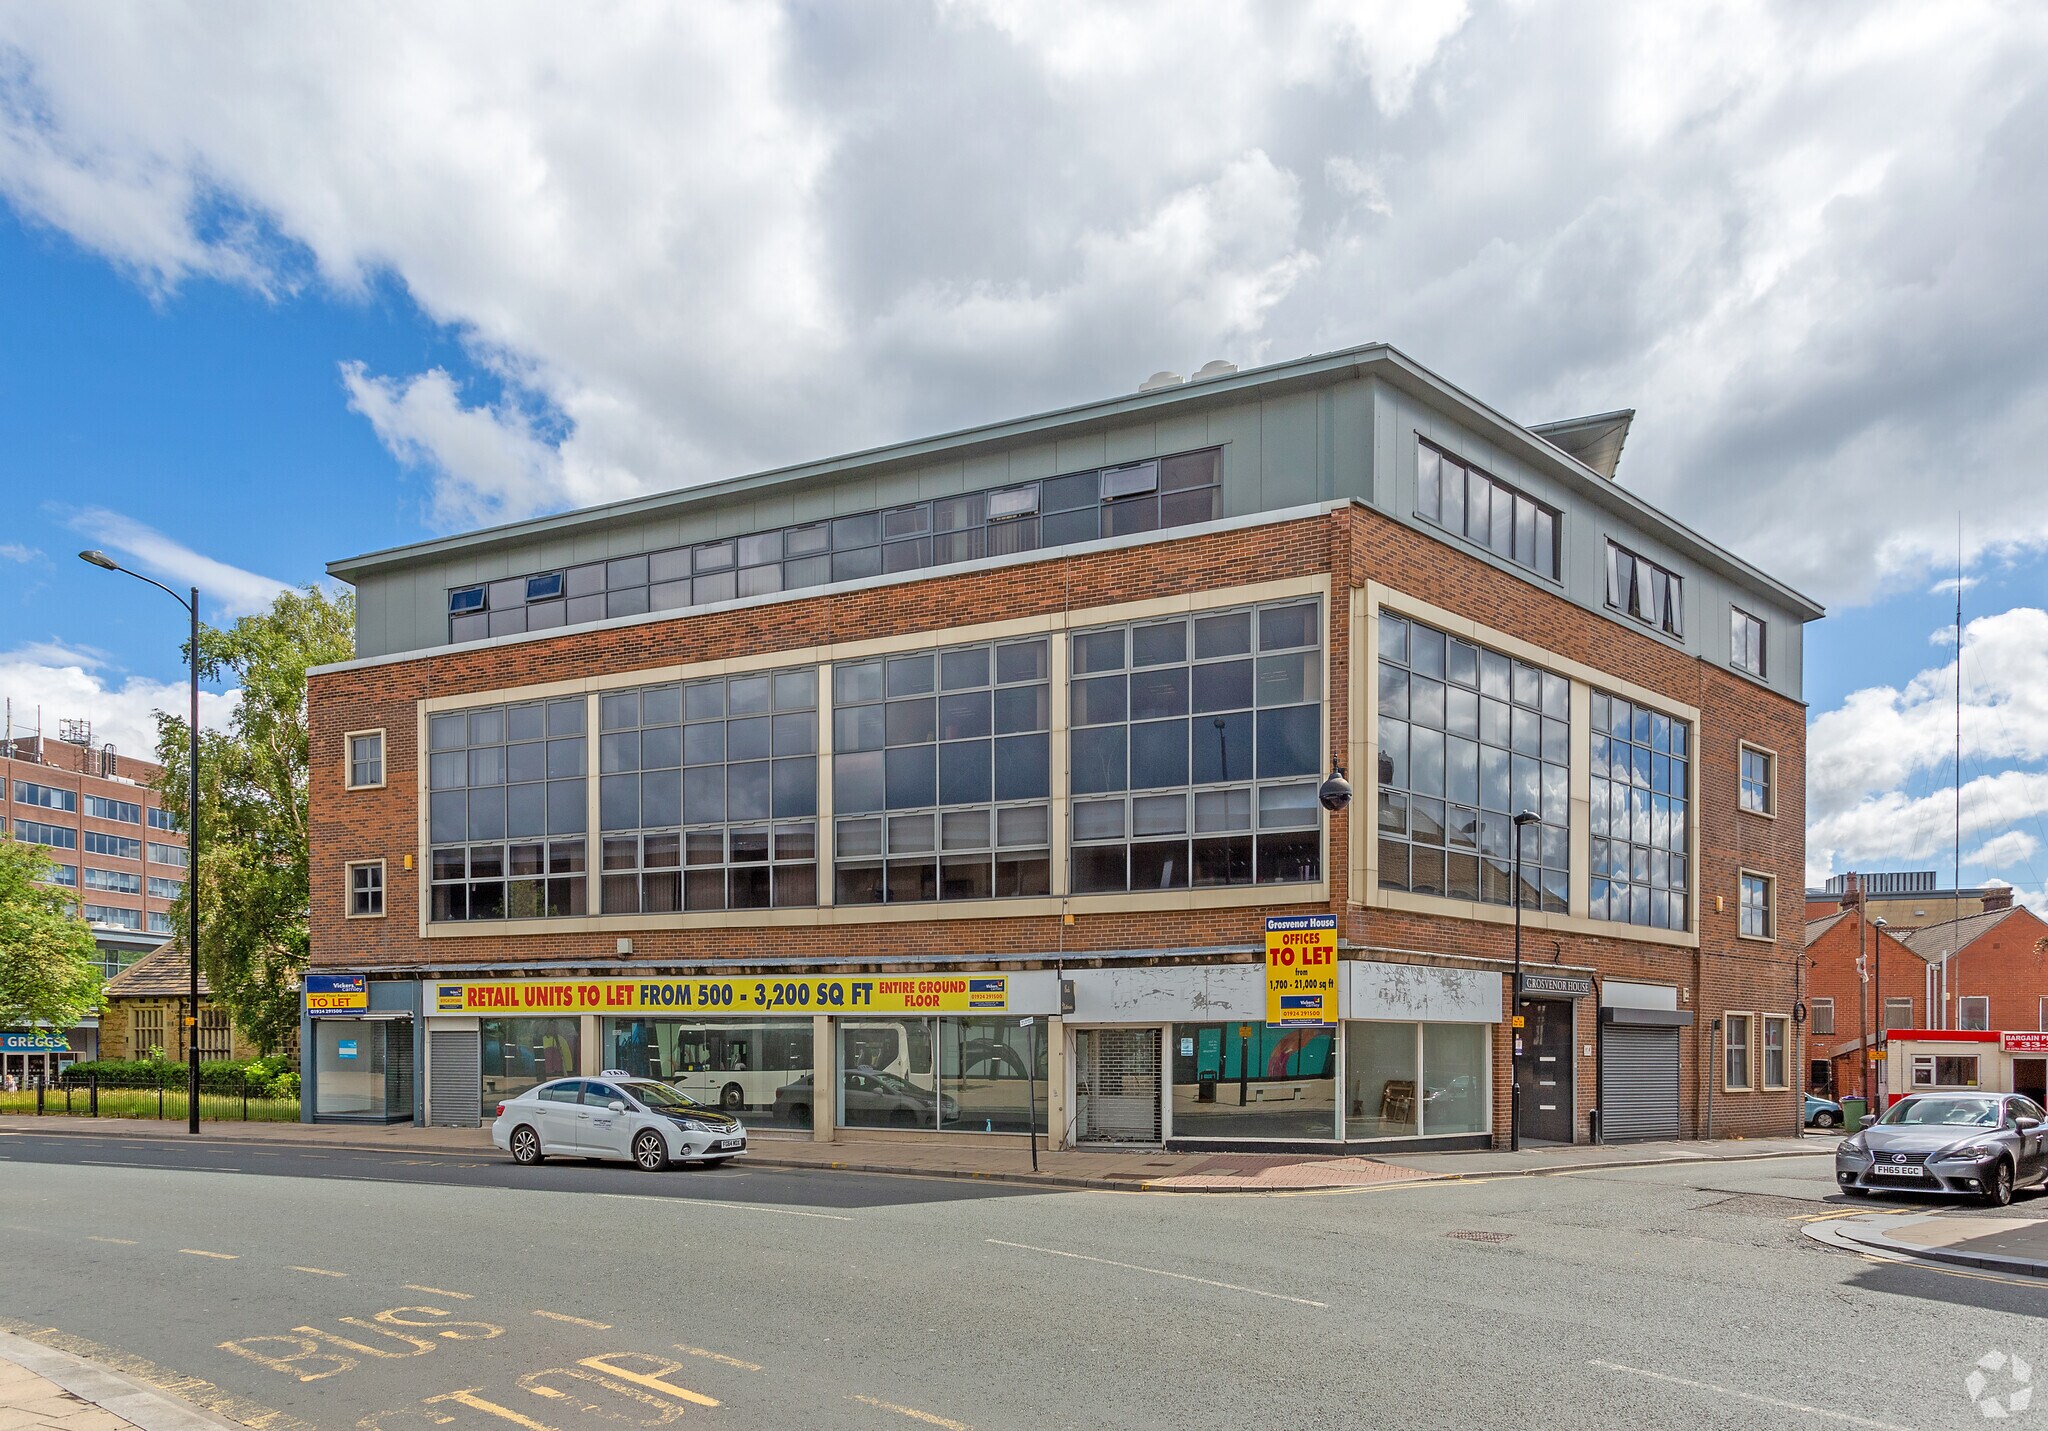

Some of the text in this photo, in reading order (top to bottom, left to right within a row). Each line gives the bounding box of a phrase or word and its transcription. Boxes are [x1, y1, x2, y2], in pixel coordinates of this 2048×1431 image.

[1268, 918, 1334, 929] Grosvenor House
[1282, 933, 1320, 945] OFFICES
[1270, 946, 1333, 966] TO LET
[1295, 968, 1308, 976] from
[879, 981, 966, 993] ENTIRE GROUND
[1270, 980, 1288, 991] 1,700
[1295, 979, 1317, 990] 21,000
[1319, 981, 1327, 990] sq
[1527, 978, 1589, 992] GROSVENOR HOUSE
[311, 998, 351, 1007] TO LET
[468, 987, 519, 1007] RETAIL
[525, 986, 573, 1006] UNITS
[578, 985, 600, 1006] TO
[607, 985, 634, 1005] LET
[640, 984, 692, 1005] FROM
[697, 984, 733, 1005] 500
[754, 983, 810, 1010] 3,200
[816, 983, 844, 1006] SQ
[852, 983, 873, 1005] FT
[904, 994, 940, 1006] FLOOR
[7, 1036, 63, 1047] GREGGS
[215, 1306, 504, 1382] BUS
